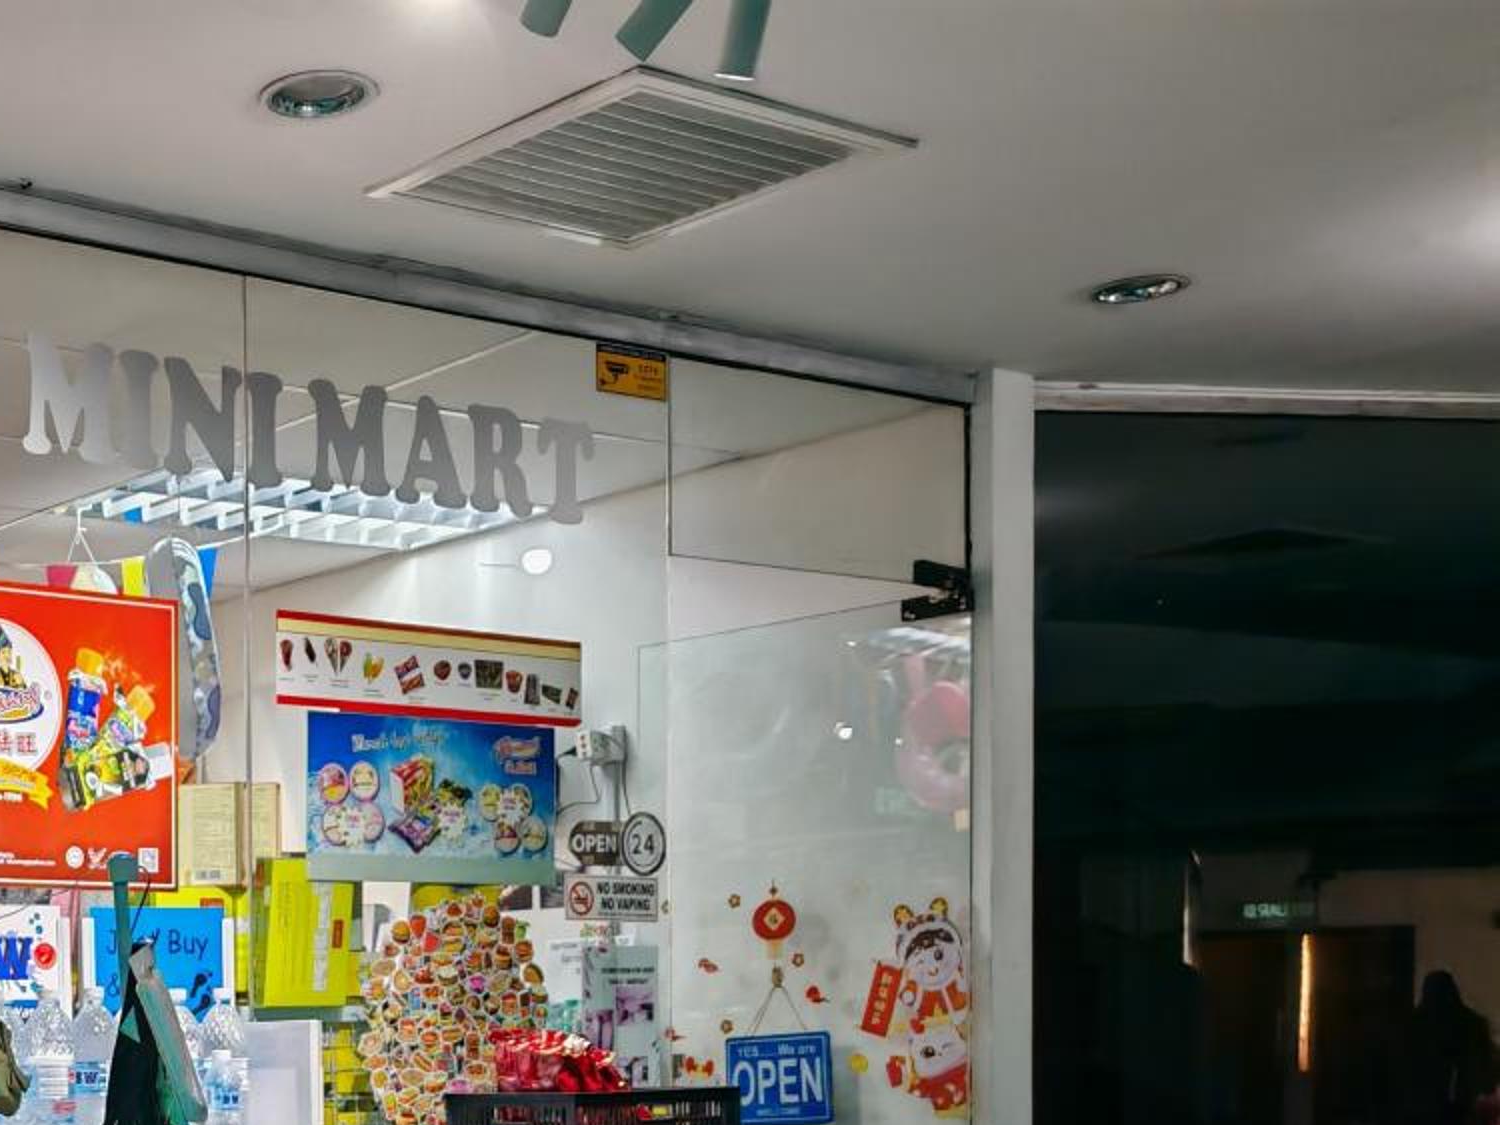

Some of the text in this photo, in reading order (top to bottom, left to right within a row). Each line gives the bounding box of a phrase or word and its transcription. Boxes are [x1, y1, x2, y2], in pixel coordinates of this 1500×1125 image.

[22, 328, 285, 490] MINI
[309, 378, 594, 526] MART
[571, 833, 618, 853] OPEN
[631, 832, 655, 856] 24
[596, 881, 655, 897] NO SMOKING
[600, 897, 651, 911] NO VAPING
[167, 929, 209, 960] Buy
[731, 1056, 823, 1107] OPEN
